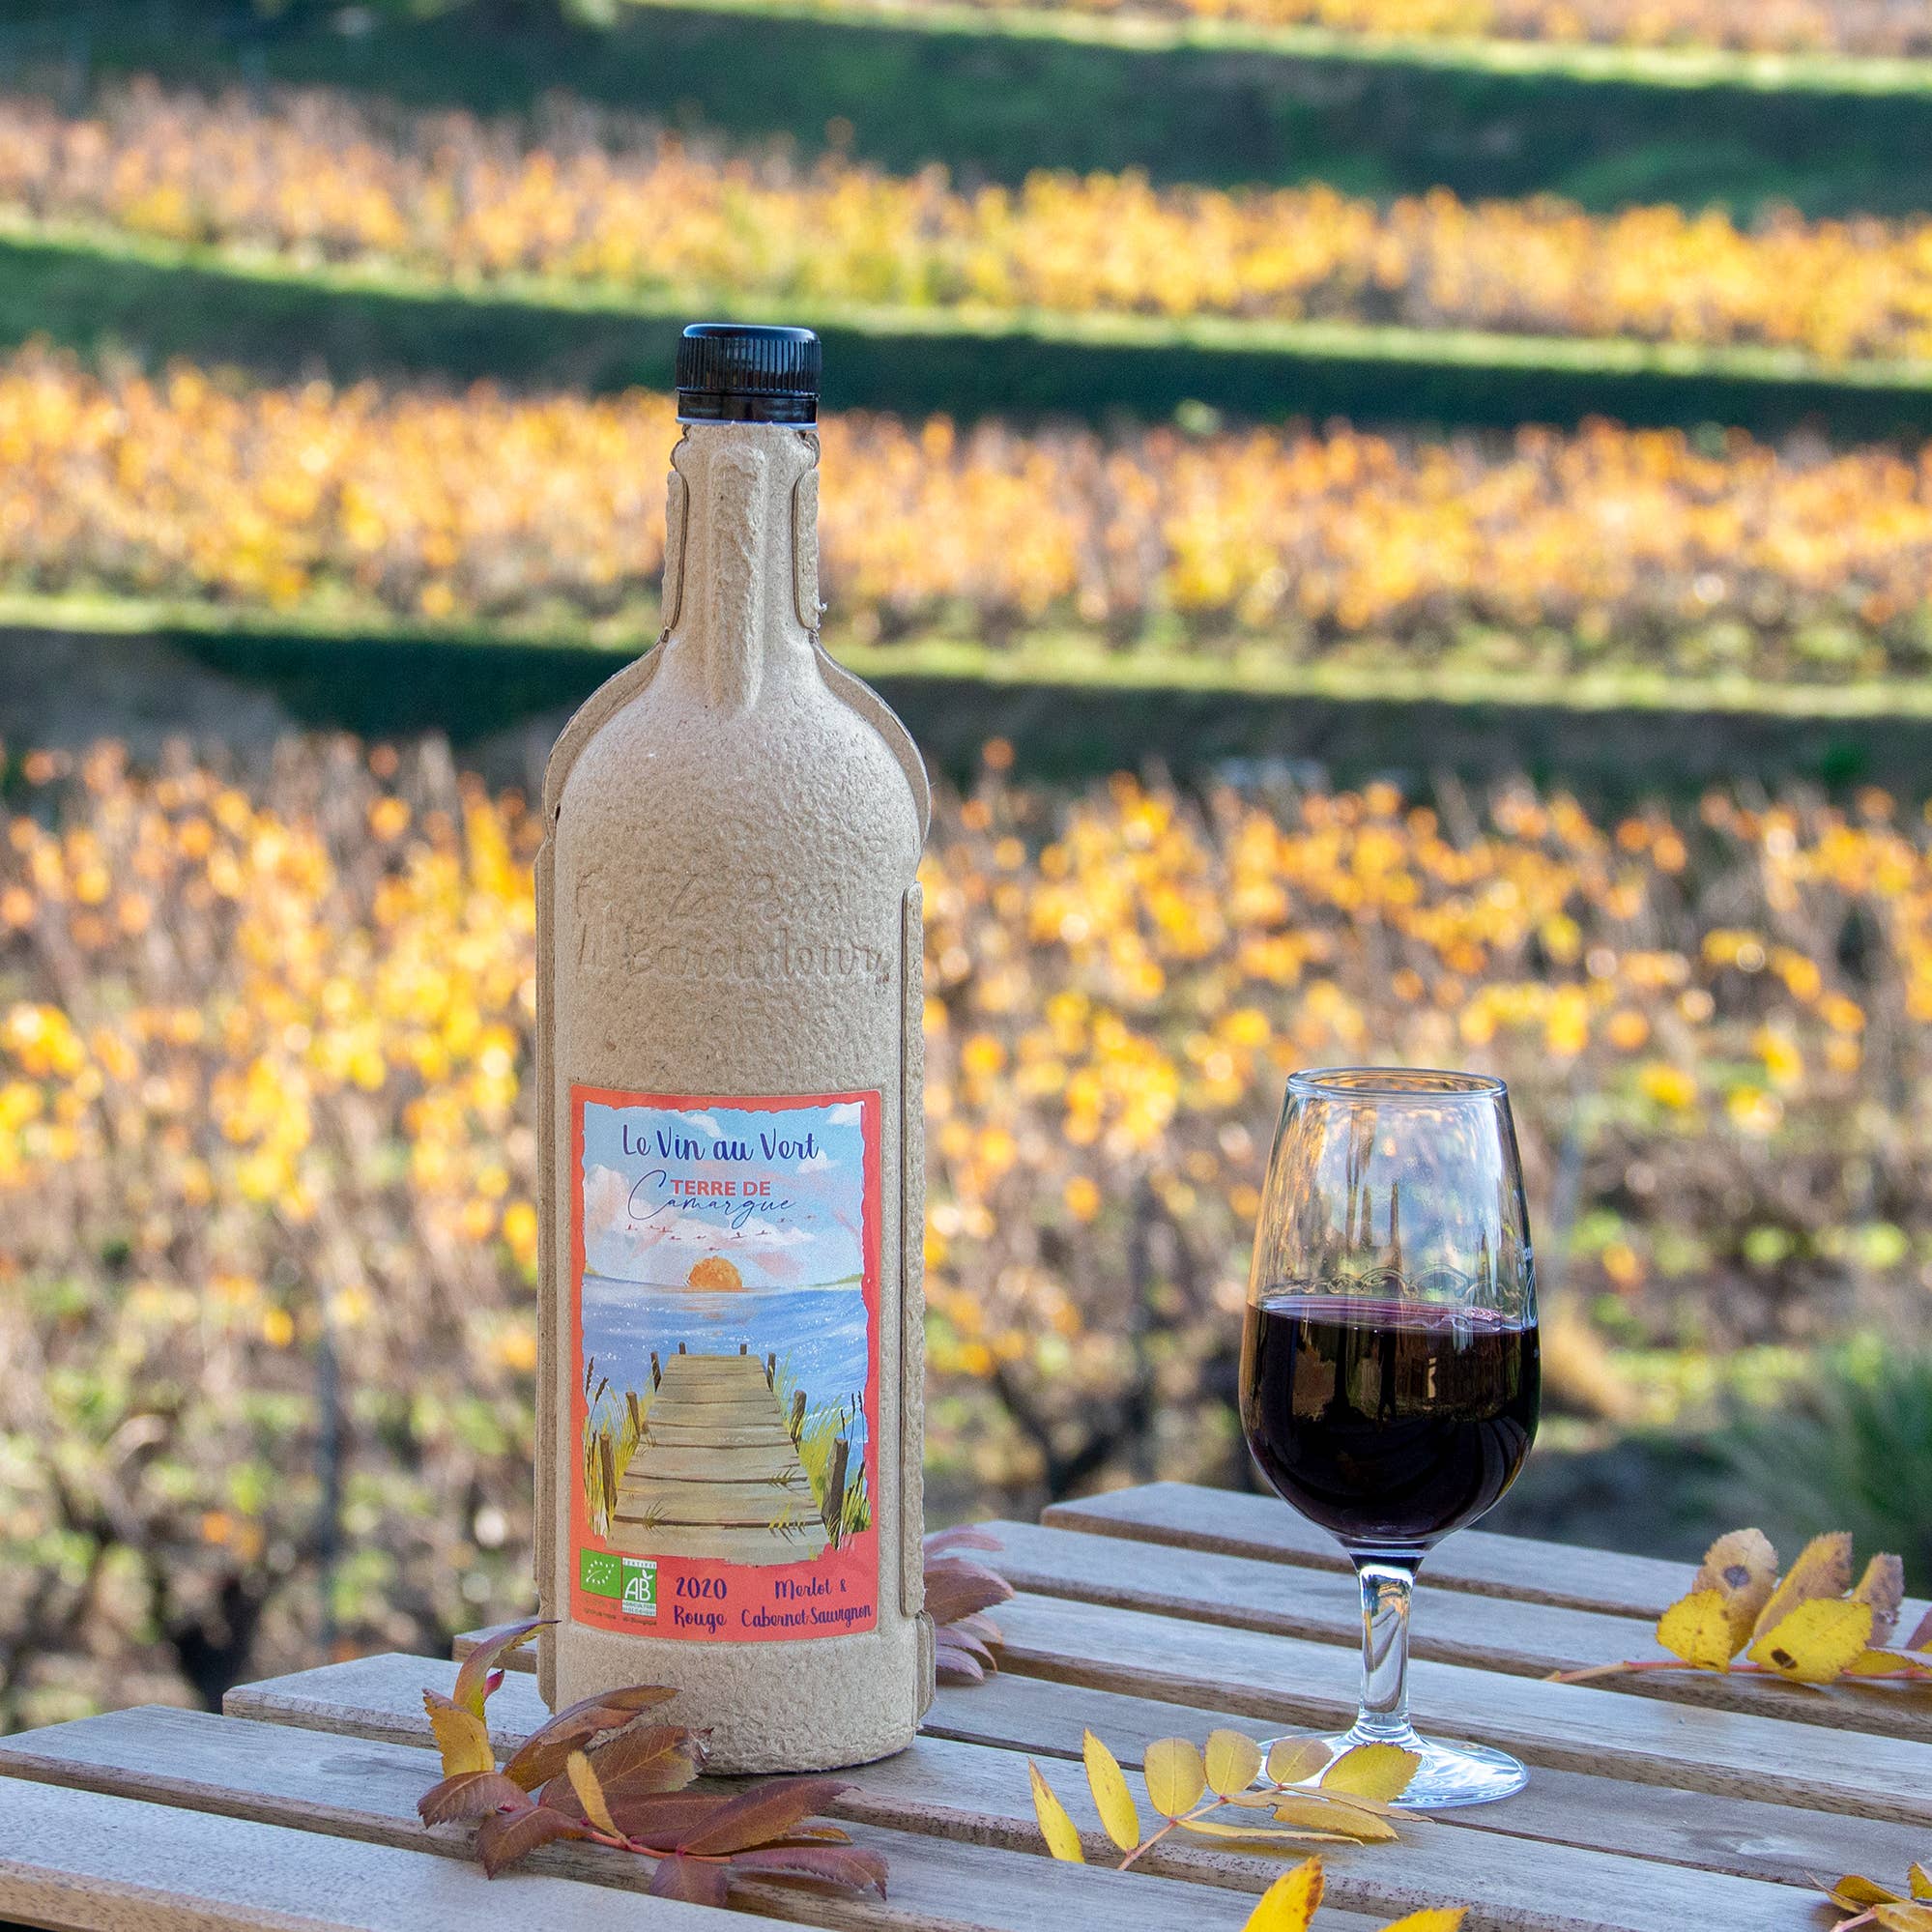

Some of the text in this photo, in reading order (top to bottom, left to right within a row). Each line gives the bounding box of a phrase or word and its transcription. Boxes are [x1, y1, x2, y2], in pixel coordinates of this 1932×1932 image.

[623, 1124, 819, 1160] Le Vin au Vert
[628, 1169, 796, 1229] Camargue
[671, 1179, 770, 1197] TERRE DE
[624, 1577, 651, 1601] AB
[676, 1576, 727, 1600] 2020
[775, 1577, 848, 1600] Merlot &
[674, 1605, 727, 1633] Rouge
[741, 1604, 871, 1628] Cabernet Sauvignon
